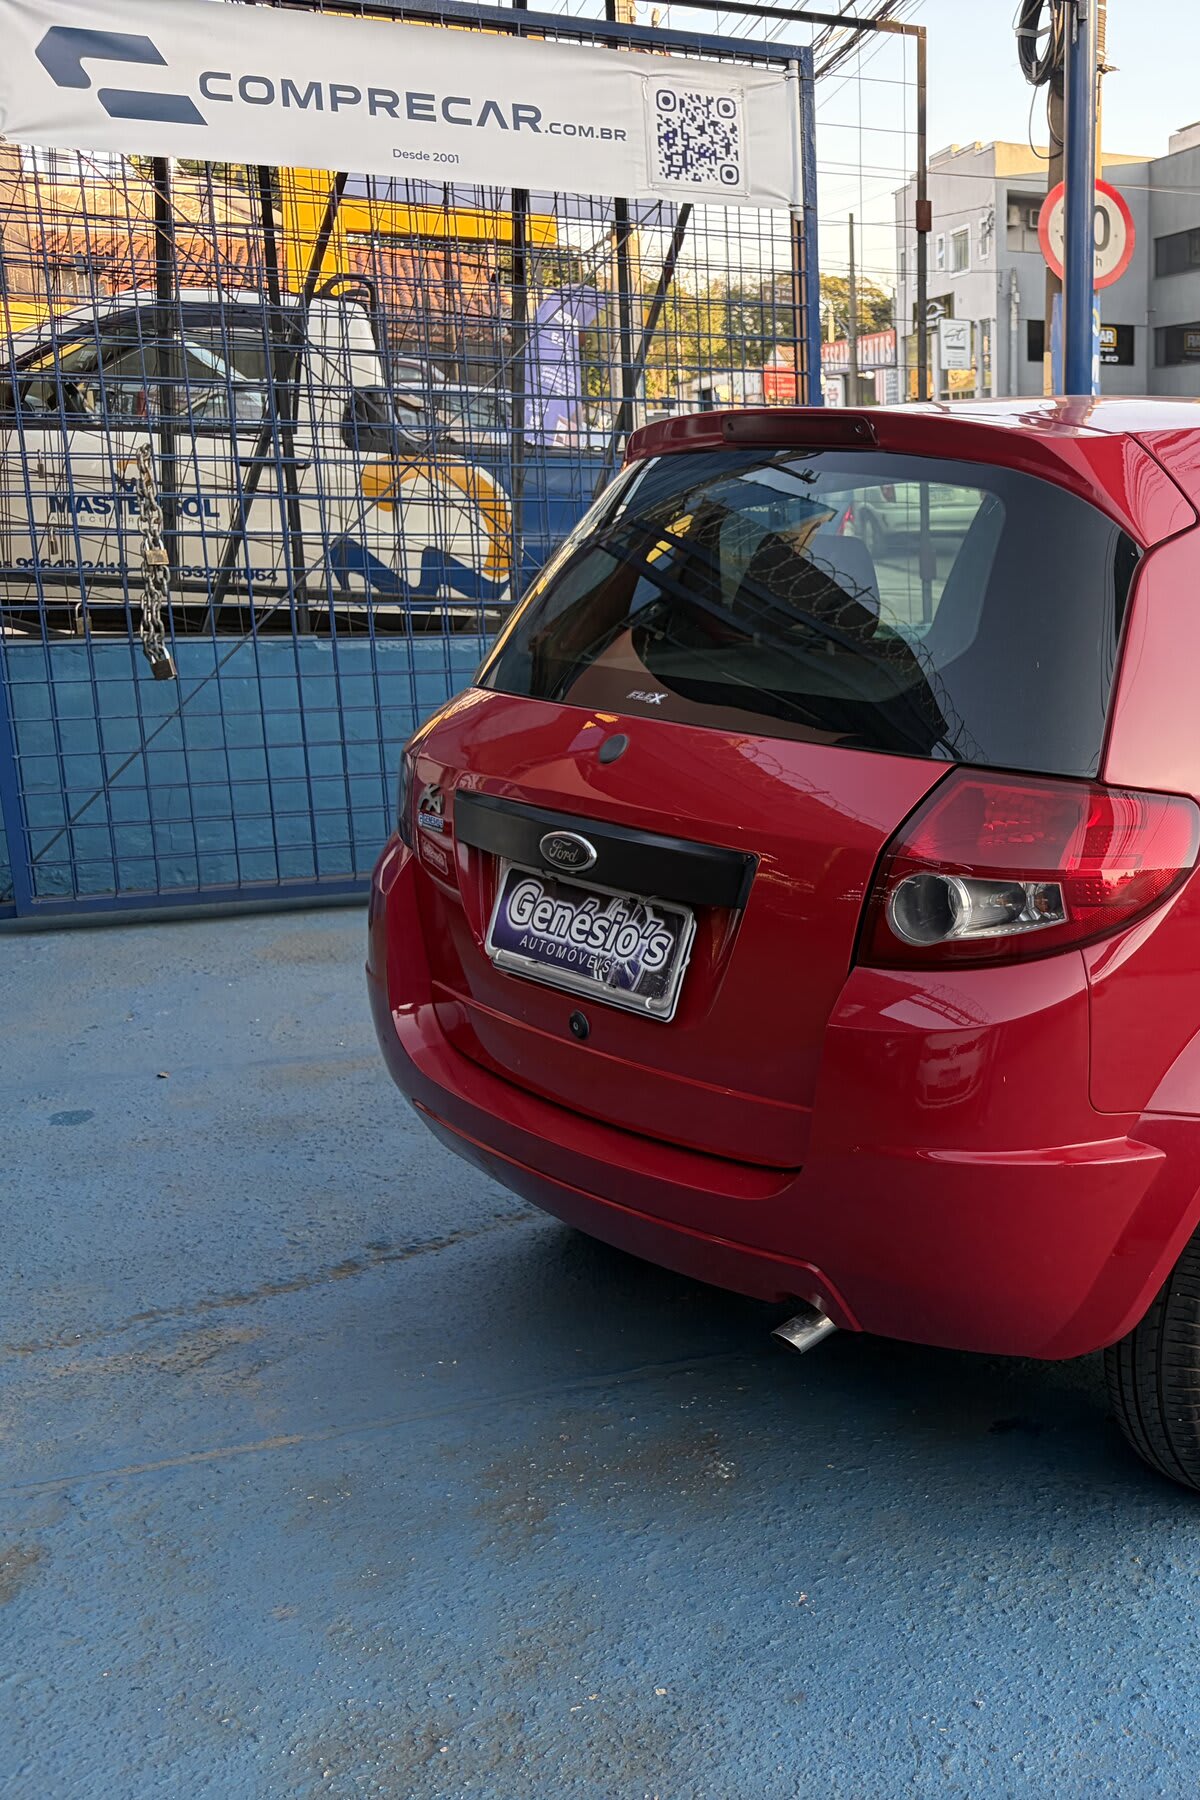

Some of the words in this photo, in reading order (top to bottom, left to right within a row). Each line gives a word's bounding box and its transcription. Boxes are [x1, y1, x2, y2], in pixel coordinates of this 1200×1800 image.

[392, 148, 430, 161] Desde
[433, 153, 460, 164] 2001
[625, 690, 669, 705] FLEX
[549, 838, 579, 863] Ford
[509, 879, 672, 966] Genésio's
[519, 934, 613, 974] AUTOMÓVEIS
